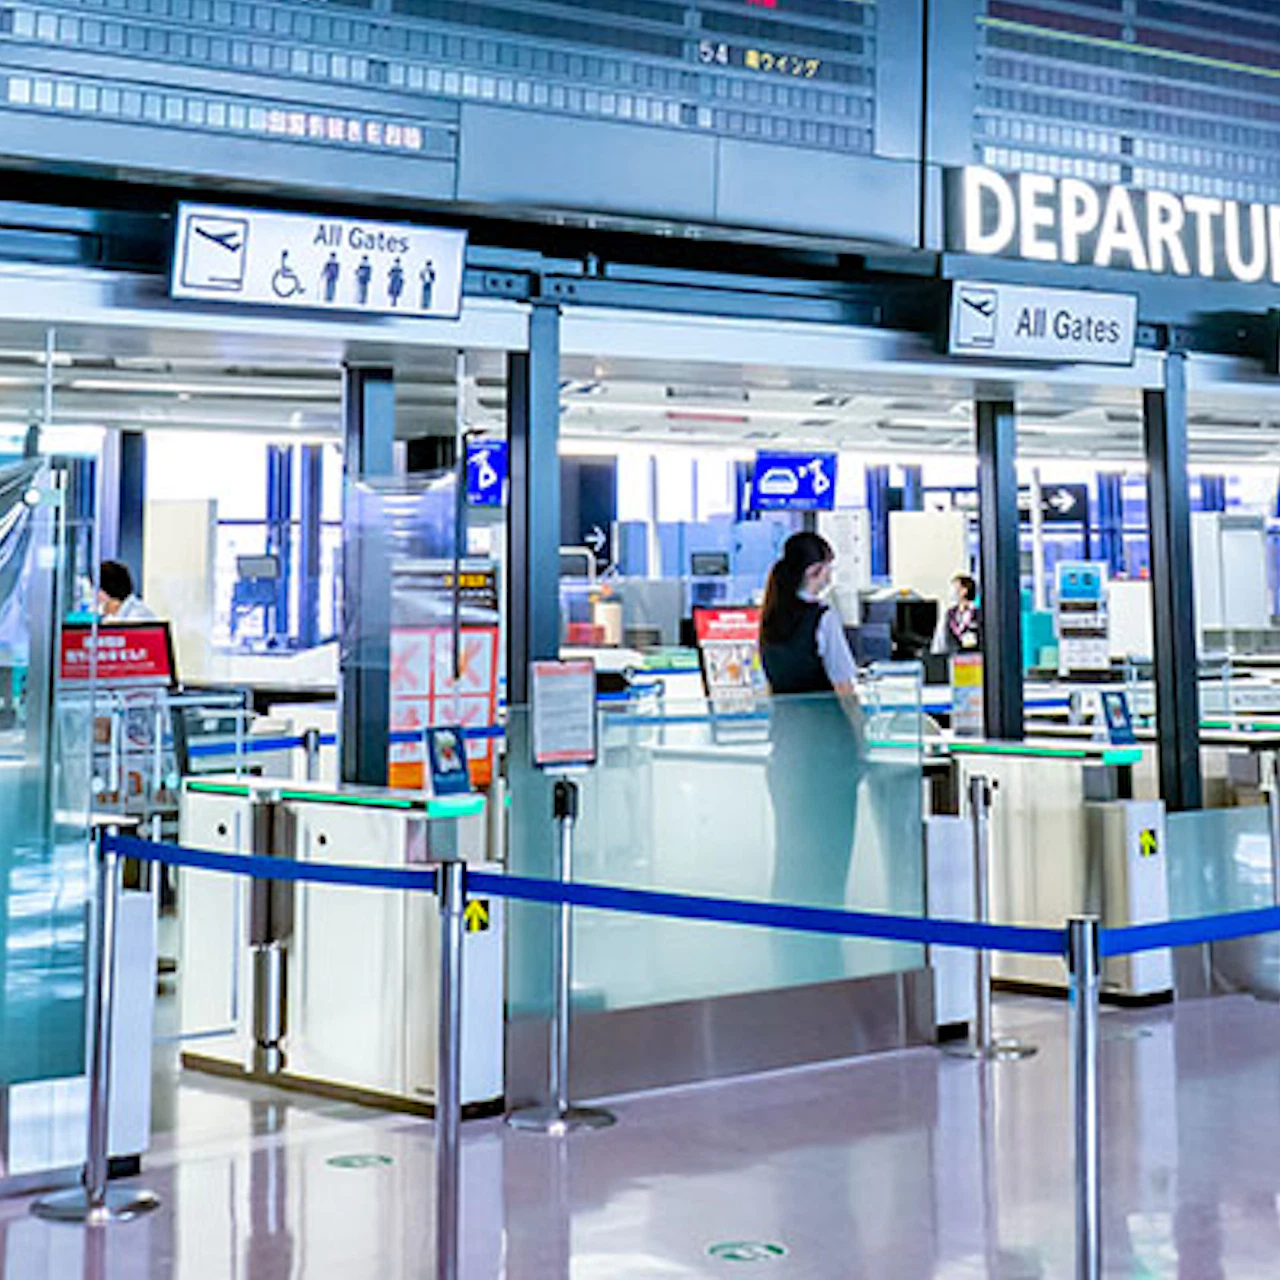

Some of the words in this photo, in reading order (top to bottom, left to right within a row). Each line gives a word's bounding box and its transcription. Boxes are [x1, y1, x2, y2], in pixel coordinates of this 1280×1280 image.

[314, 223, 343, 247] All
[348, 226, 410, 254] Gates
[1014, 306, 1046, 339] All
[1053, 309, 1121, 344] Gates
